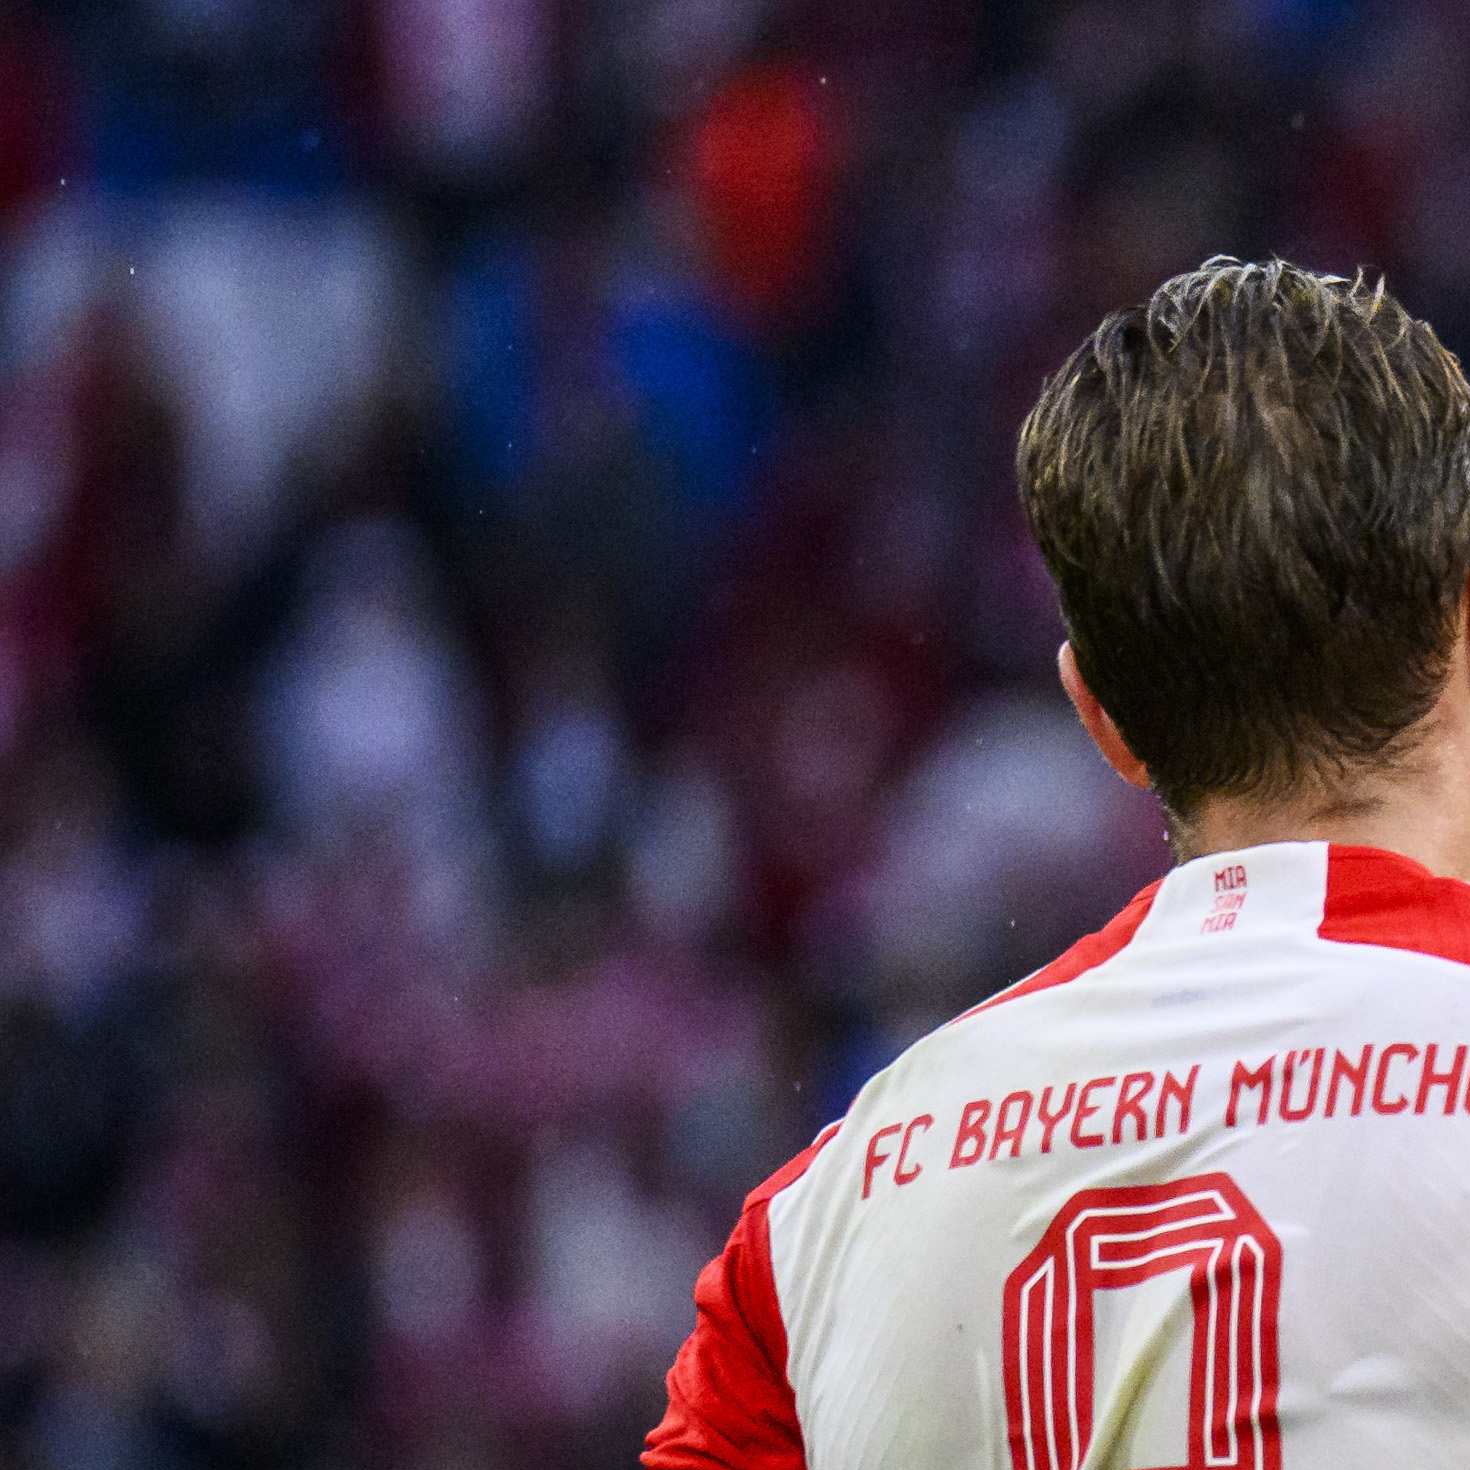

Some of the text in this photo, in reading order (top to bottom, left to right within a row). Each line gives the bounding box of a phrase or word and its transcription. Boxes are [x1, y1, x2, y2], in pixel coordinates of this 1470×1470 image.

[1213, 865, 1247, 892] MIA
[1200, 912, 1238, 934] MIA
[861, 1114, 933, 1200] FC
[949, 1063, 1202, 1170] BAYERN
